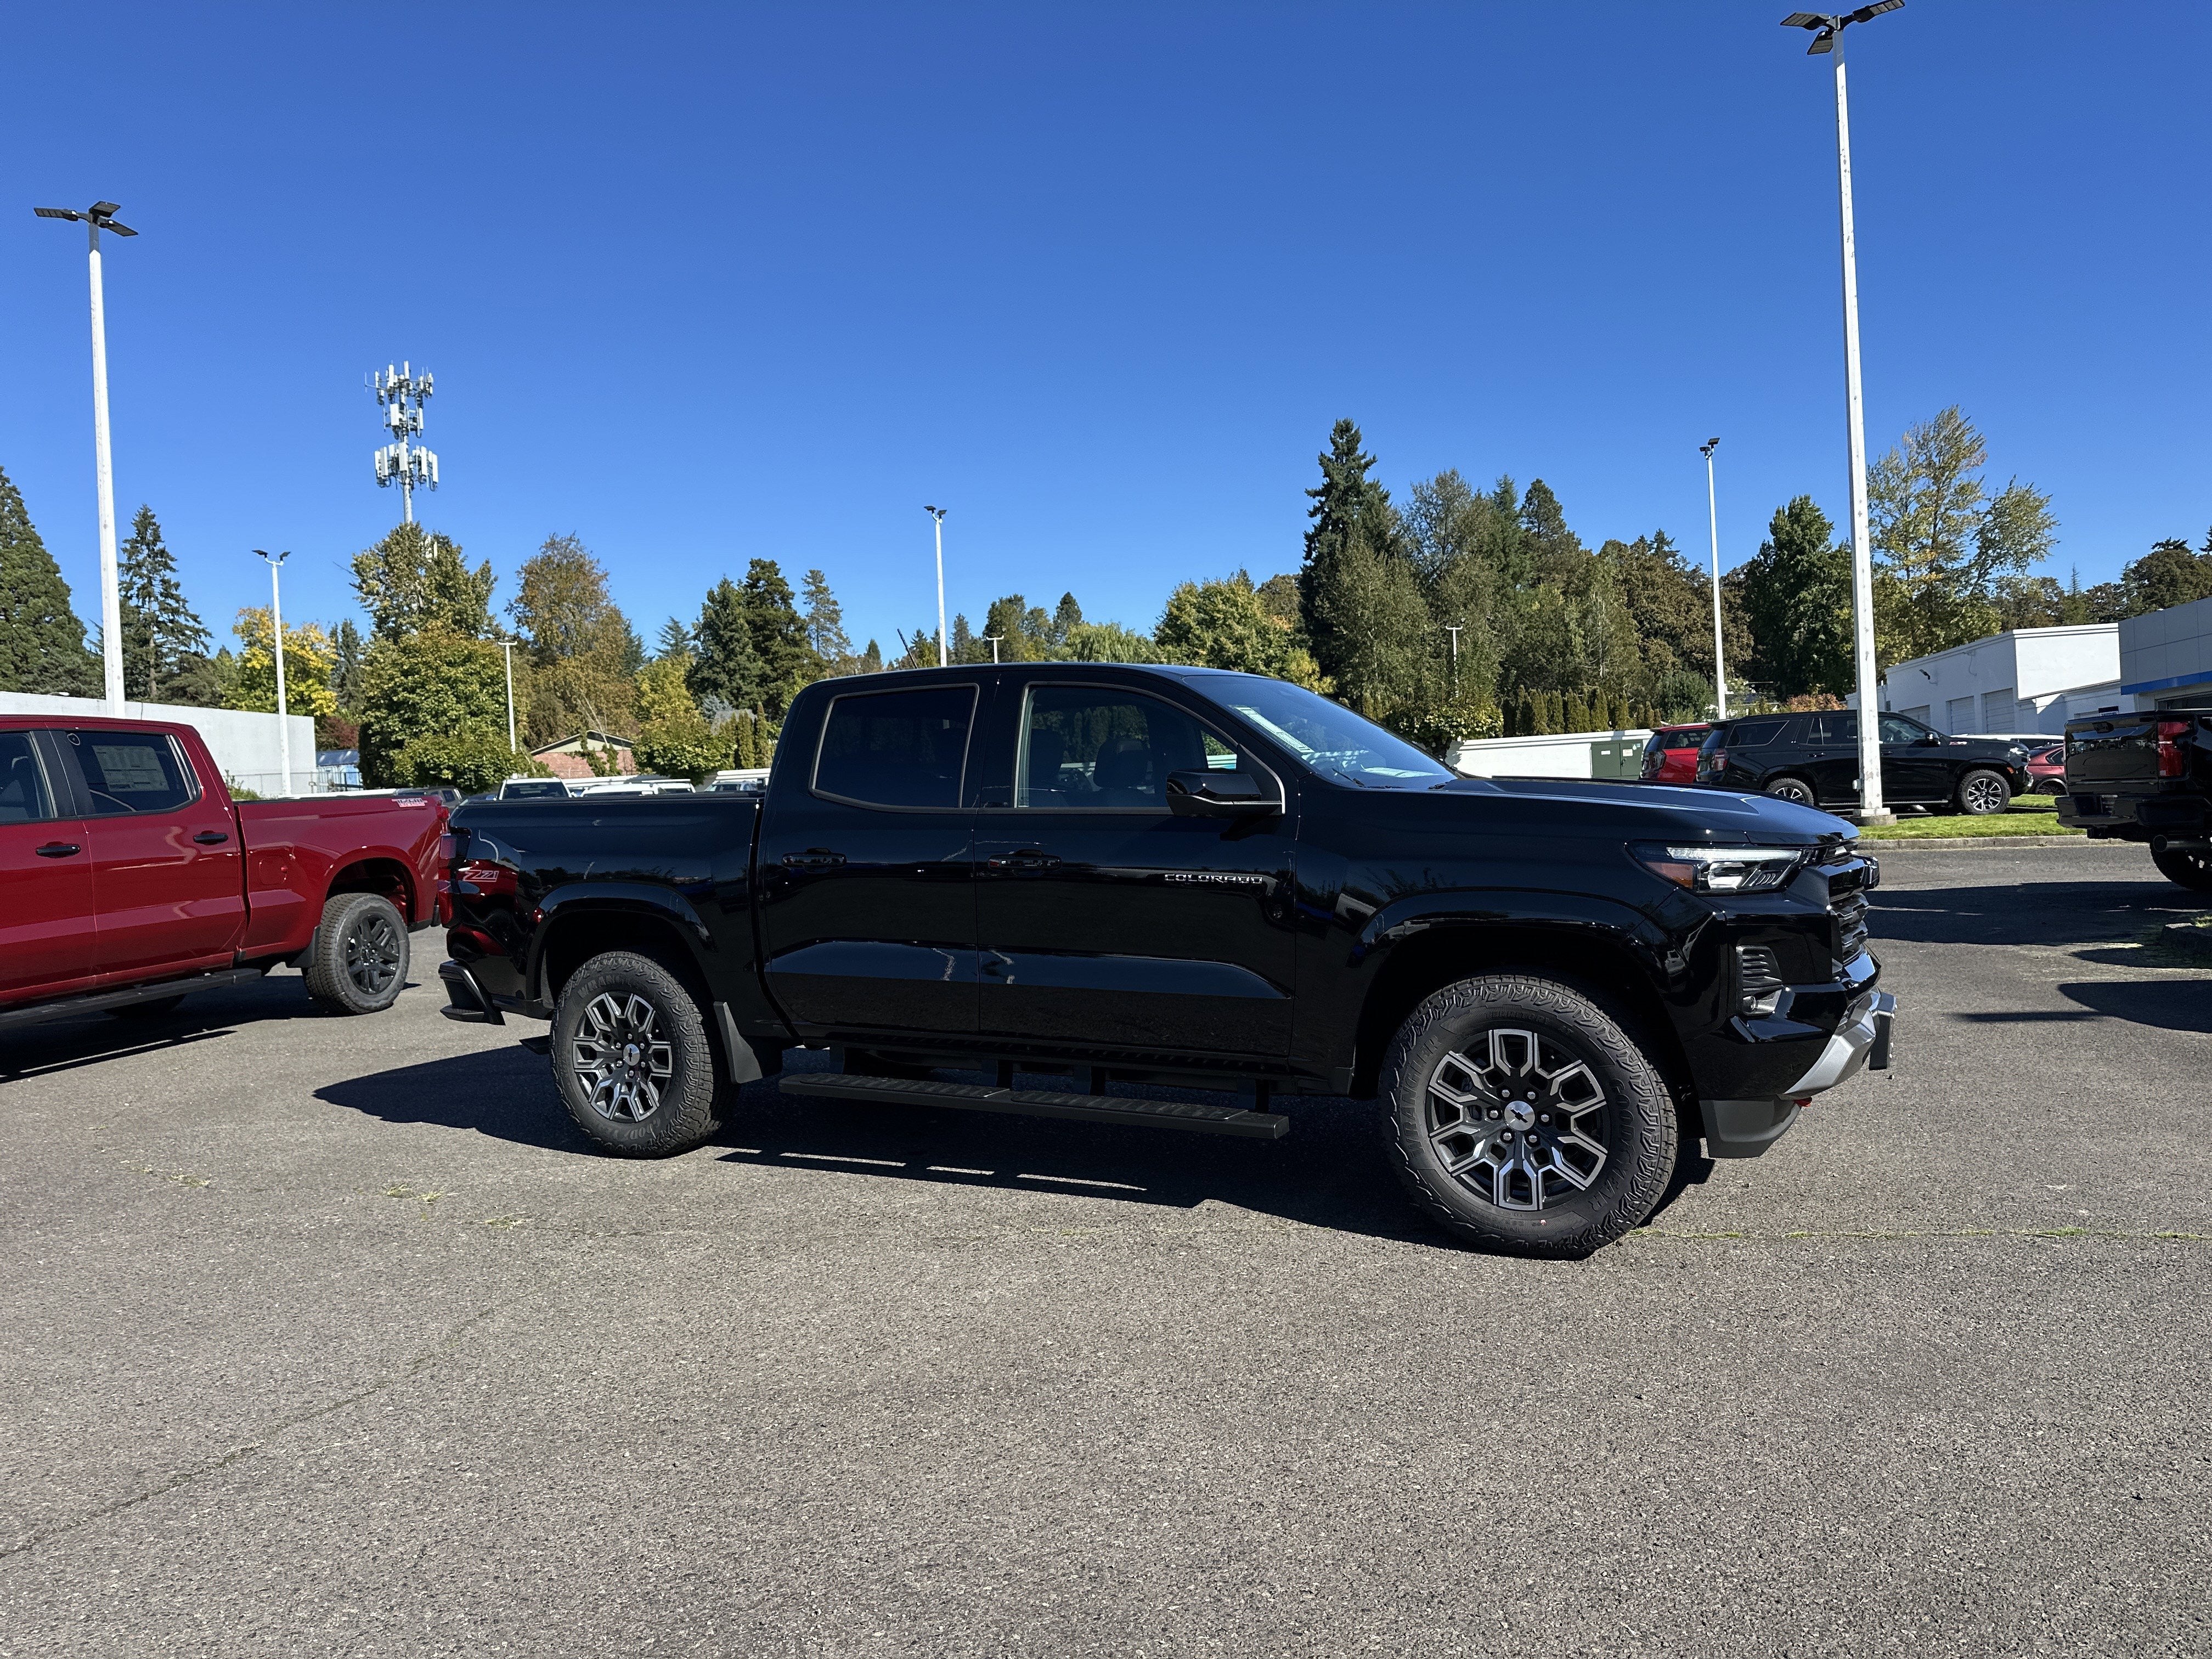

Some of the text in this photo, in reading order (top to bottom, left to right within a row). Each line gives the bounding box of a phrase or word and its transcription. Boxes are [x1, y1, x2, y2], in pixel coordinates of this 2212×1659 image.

[462, 870, 499, 882] Z71
[1164, 874, 1263, 884] COLORADO
[1401, 1035, 1443, 1159] WRANGLER
[1588, 1078, 1636, 1212] GOODYEAR
